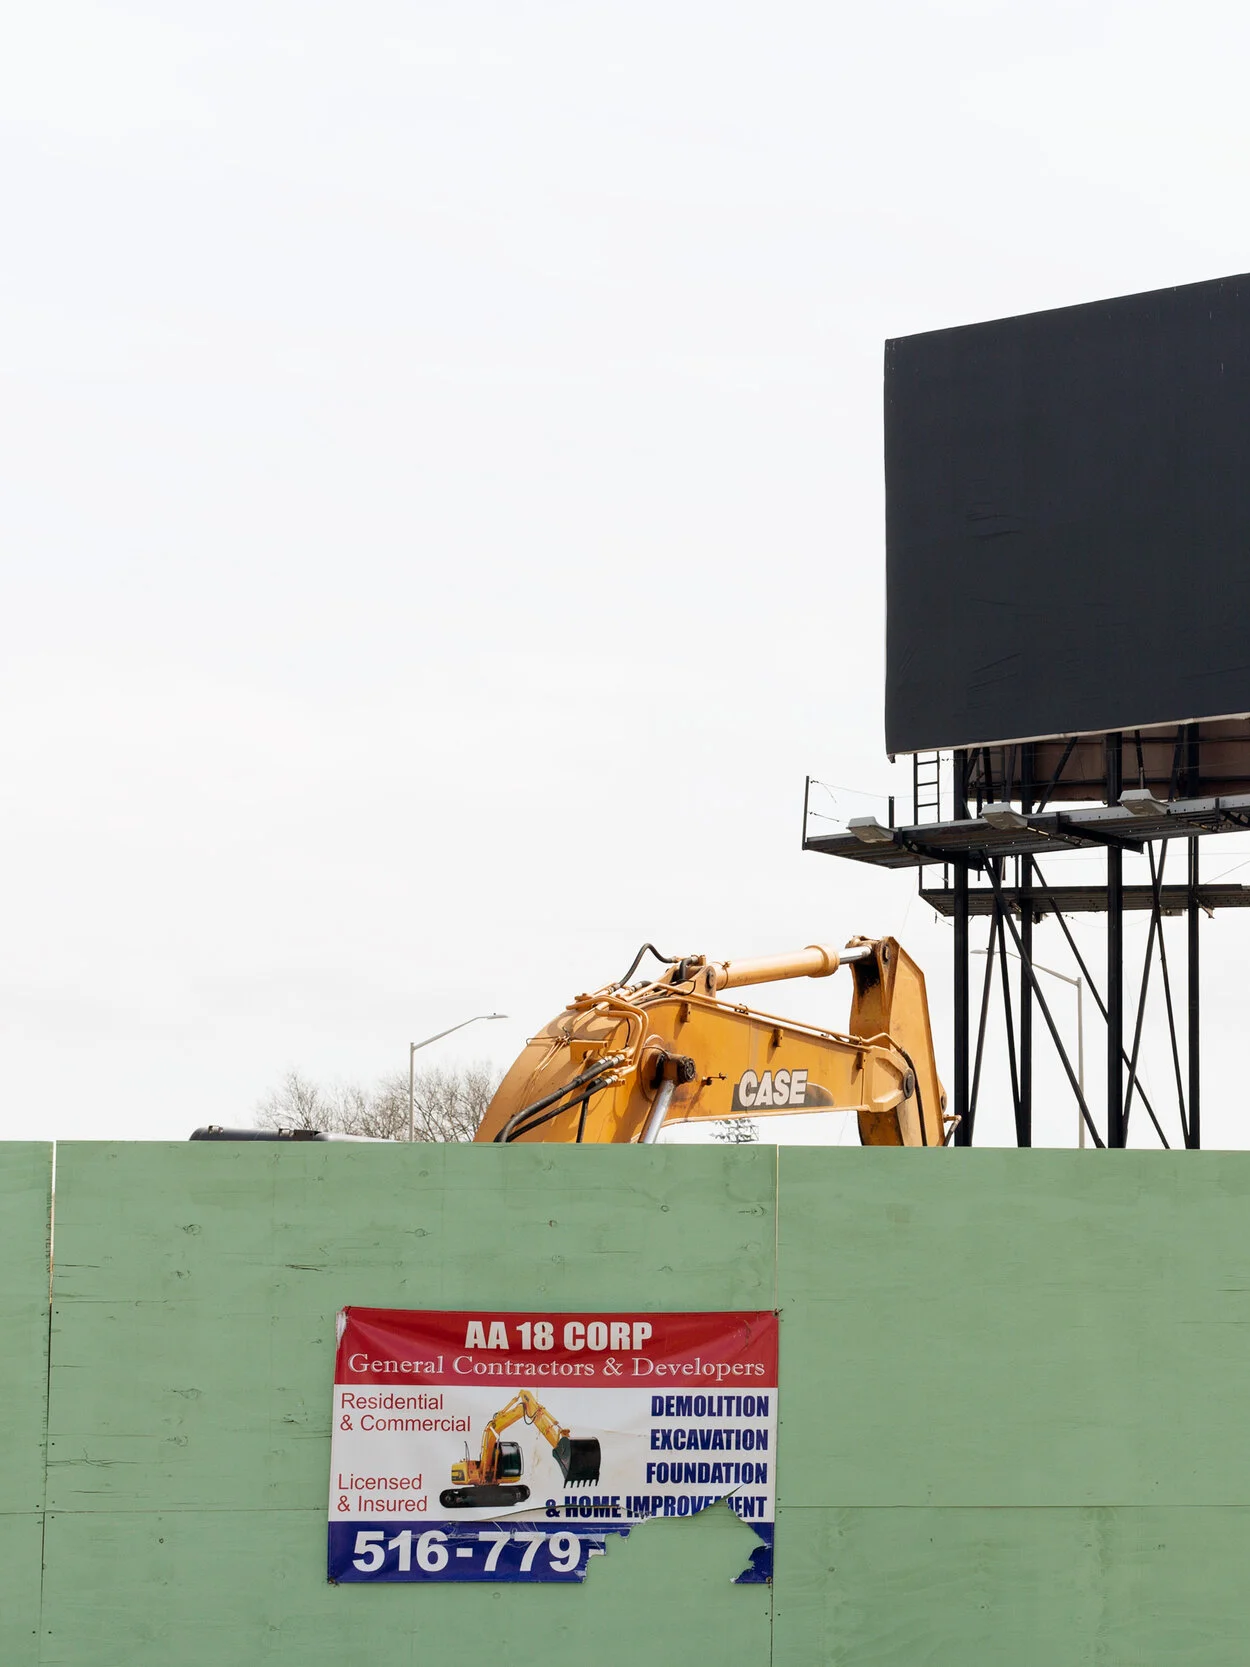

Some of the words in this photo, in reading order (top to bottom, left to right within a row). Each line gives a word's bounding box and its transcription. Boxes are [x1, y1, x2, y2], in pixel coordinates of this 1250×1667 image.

[739, 1069, 808, 1108] CASE
[464, 1321, 509, 1350] AA
[515, 1321, 554, 1351] 18
[563, 1321, 652, 1352] CORP
[348, 1353, 444, 1375] General
[452, 1355, 596, 1377] Contractors
[602, 1357, 624, 1376] &
[631, 1357, 766, 1382] Developers
[341, 1392, 444, 1411] Residential
[650, 1395, 769, 1418] DEMOLITION
[339, 1415, 354, 1432] &
[359, 1415, 471, 1433] Commercial
[649, 1428, 769, 1451] EXCAVATION
[338, 1473, 423, 1491] Licensed
[645, 1462, 768, 1485] FOUNDATION
[337, 1495, 351, 1513] &
[357, 1495, 428, 1513] Insured
[545, 1497, 561, 1519] &
[564, 1495, 622, 1519] HOME
